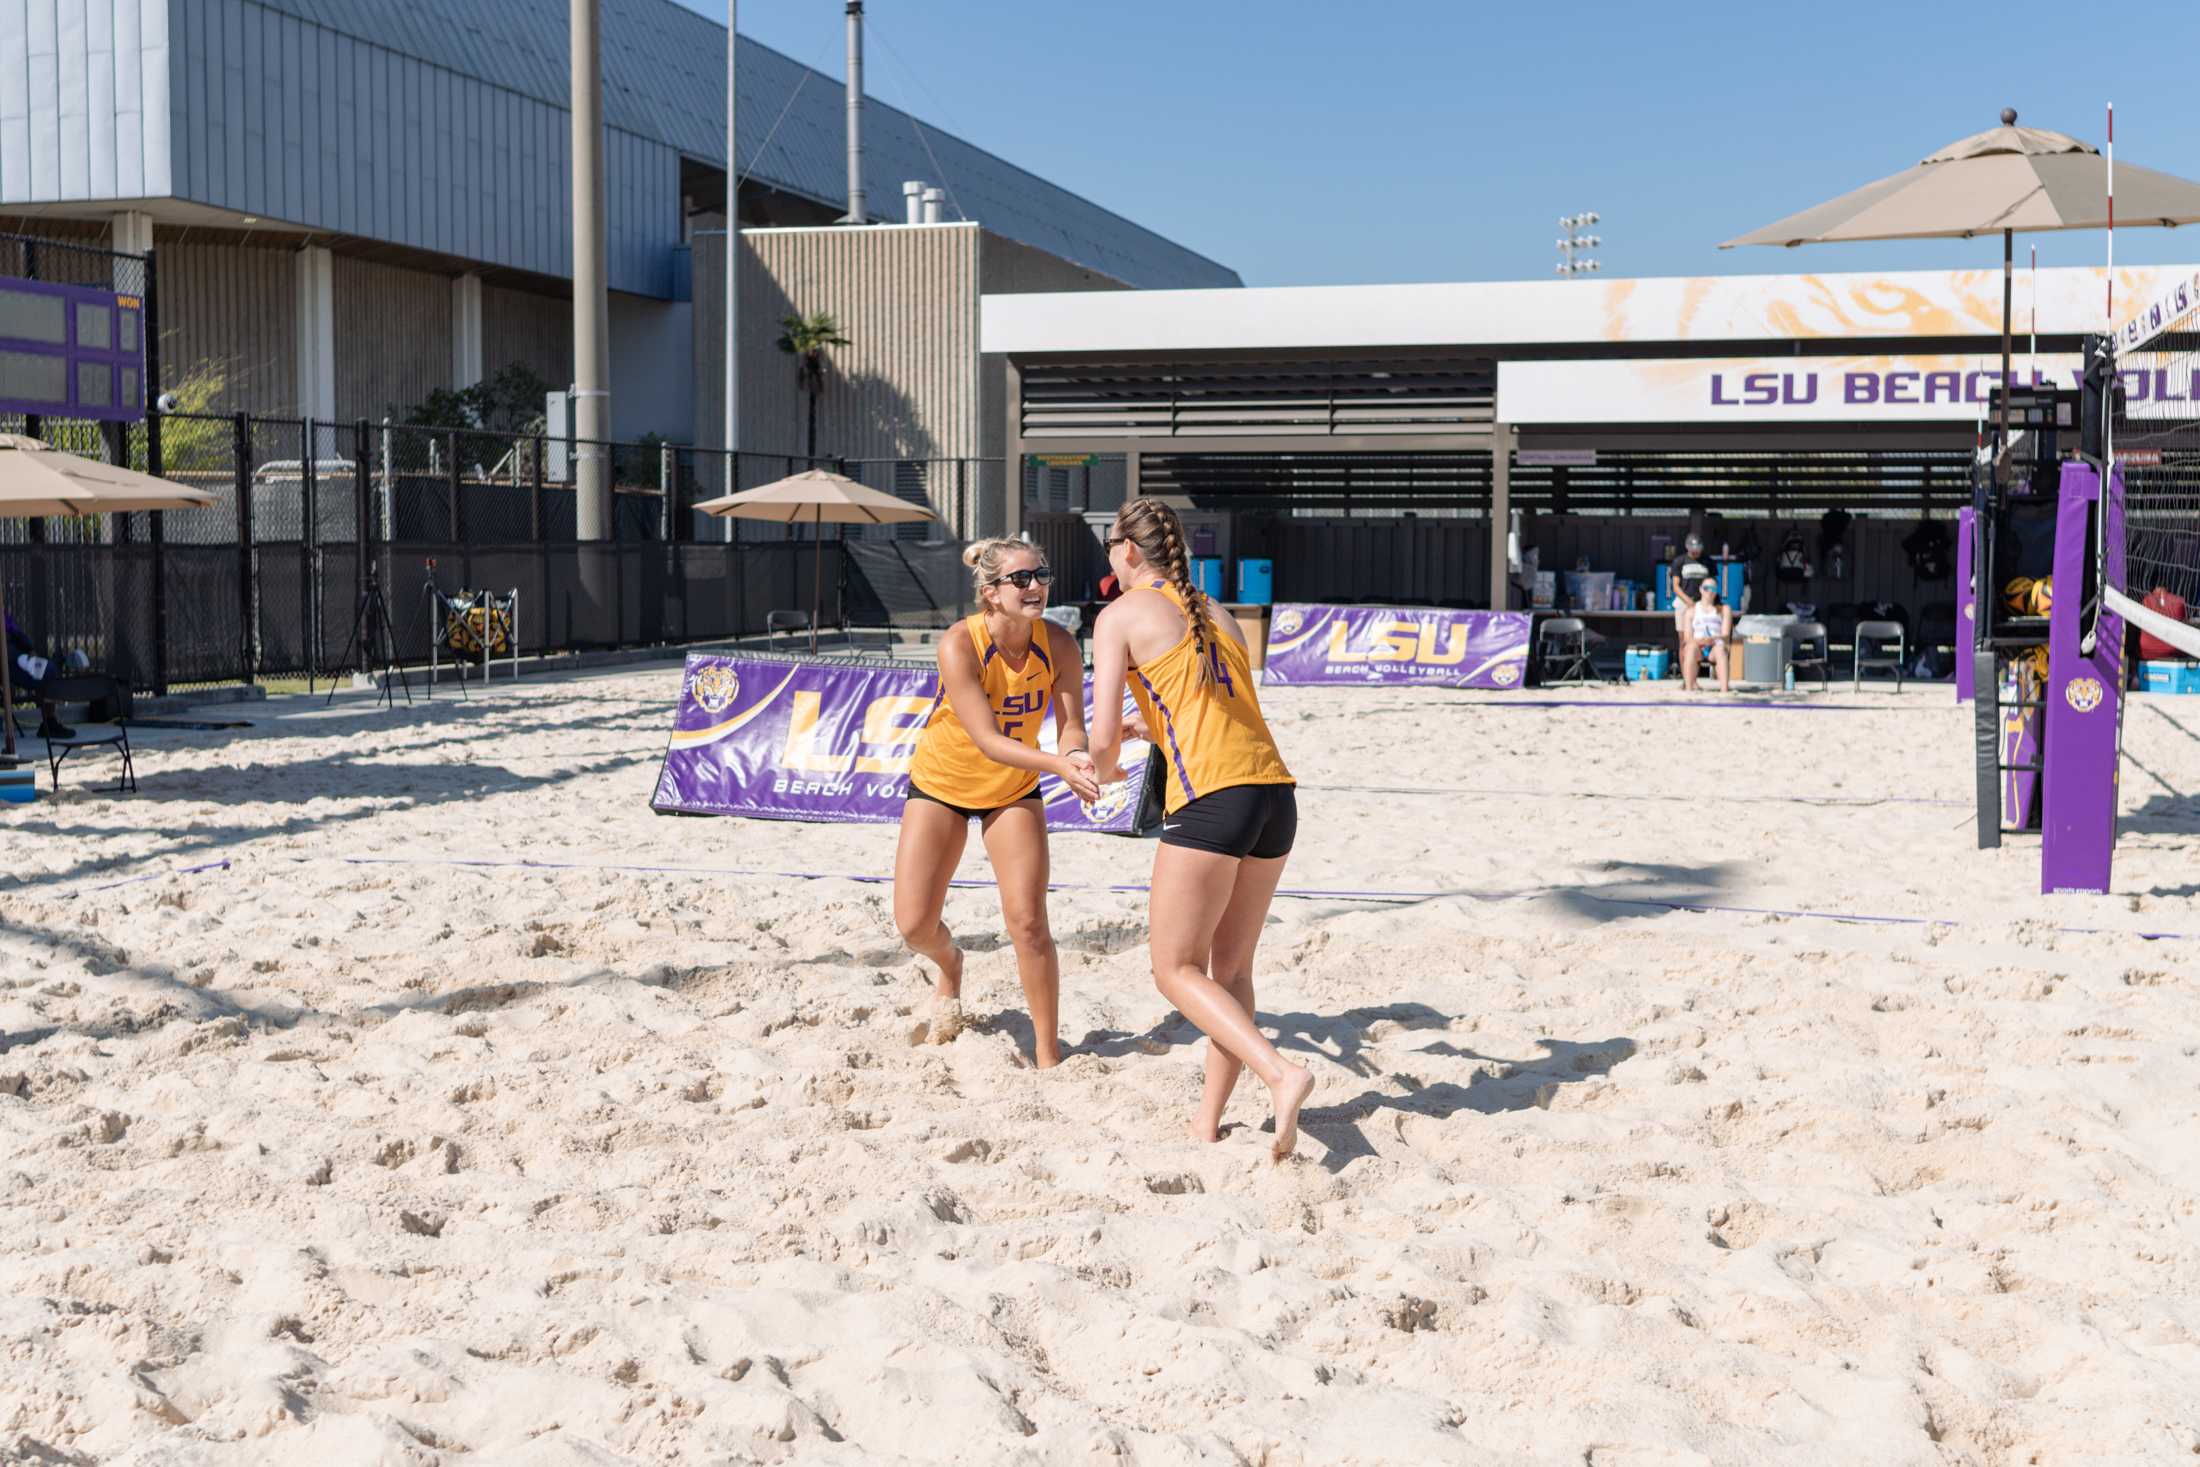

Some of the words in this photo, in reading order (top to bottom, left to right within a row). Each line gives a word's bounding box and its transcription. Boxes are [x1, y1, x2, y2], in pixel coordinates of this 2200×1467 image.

[117, 295, 140, 309] WON
[1711, 373, 1818, 405] LSU
[1327, 620, 1468, 664] LSU
[1325, 664, 1369, 675] BEACH
[1375, 664, 1461, 676] VOLLEYBALL
[993, 690, 1044, 716] SU
[782, 690, 937, 775] LS
[773, 779, 853, 796] BEACH
[866, 783, 909, 799] VOL
